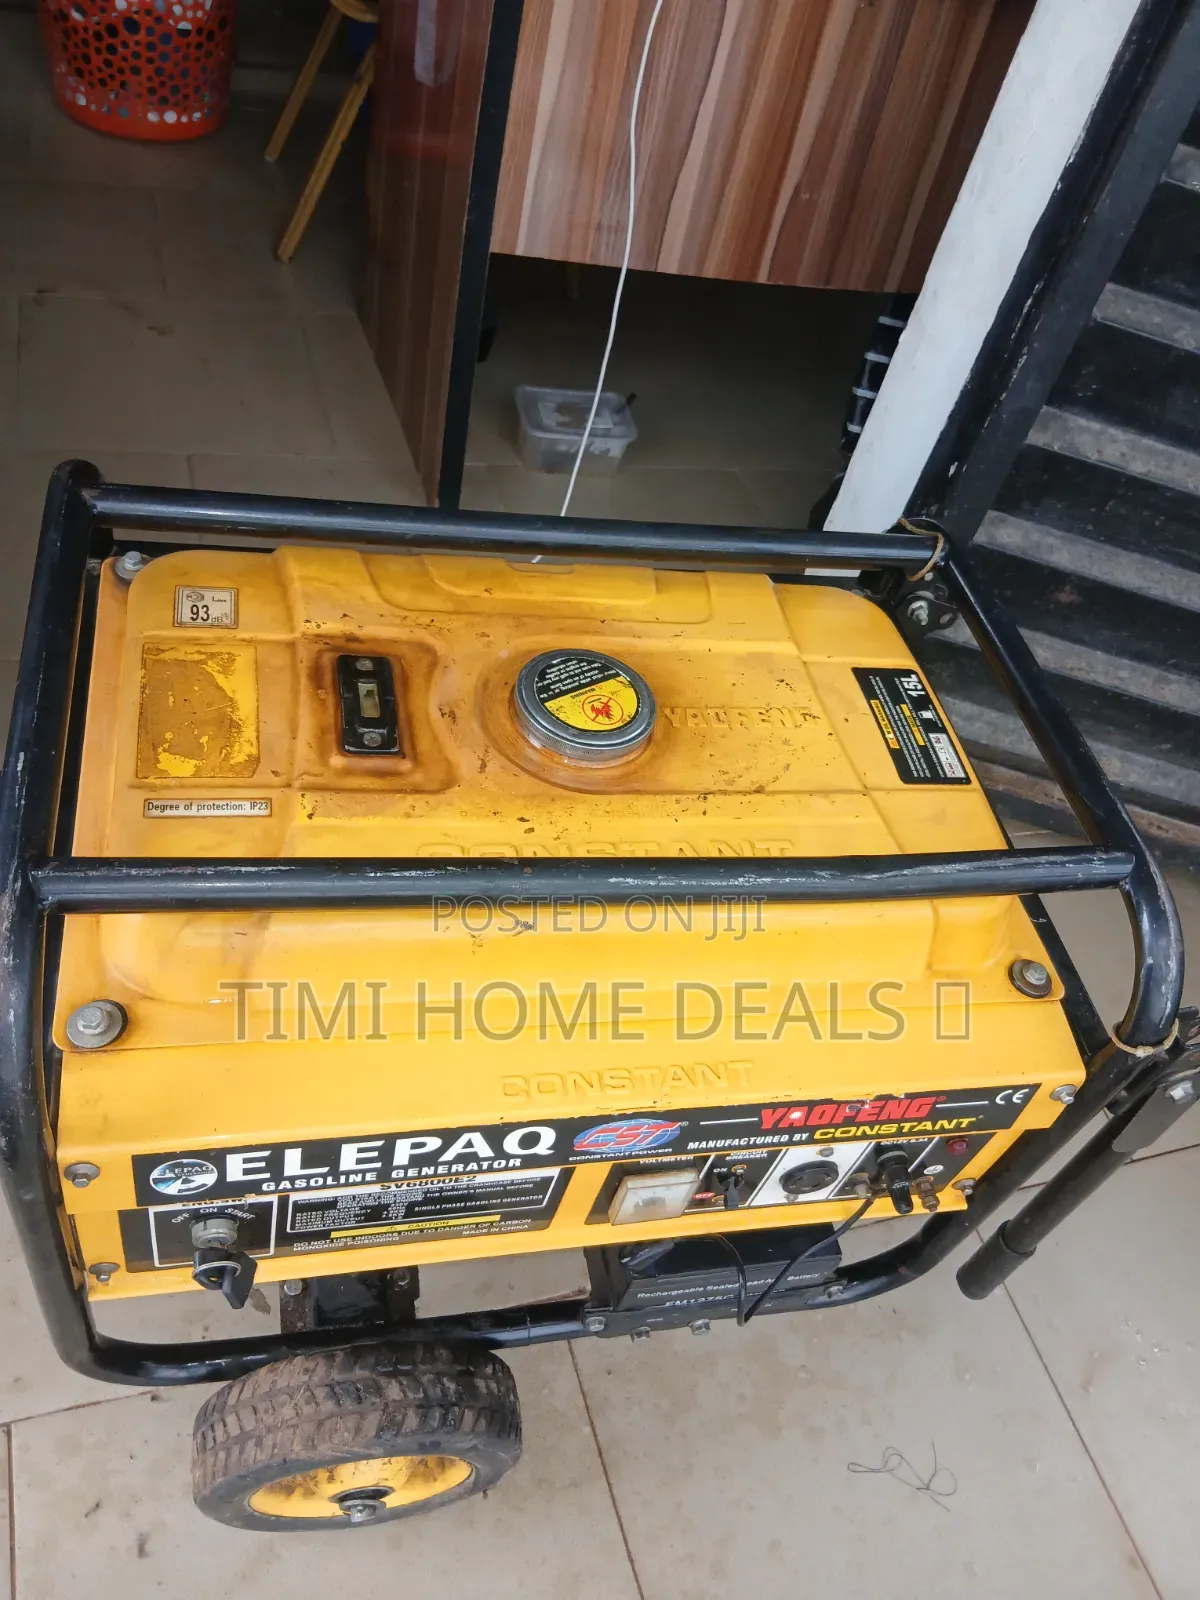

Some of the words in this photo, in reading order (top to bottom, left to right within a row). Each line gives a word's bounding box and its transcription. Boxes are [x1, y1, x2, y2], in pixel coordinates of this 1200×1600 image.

[190, 604, 210, 622] 93
[570, 688, 595, 699] WARNING
[900, 674, 926, 697] 15L
[147, 801, 180, 813] Degree
[184, 801, 193, 811] of
[197, 801, 246, 813] protection:
[250, 801, 269, 811] IP23
[500, 1060, 754, 1100] CONSTANT
[995, 1088, 1030, 1105] CE
[760, 1097, 937, 1130] YAOFENG
[687, 1134, 789, 1150] MANUFACTURED
[792, 1132, 810, 1142] BY
[813, 1117, 977, 1140] CONSTANT
[226, 1126, 557, 1182] ELEPAQ
[725, 1153, 768, 1161] BREAKER
[262, 1172, 378, 1192] GASOLINE
[391, 1157, 522, 1179] GENERATOR
[465, 1198, 501, 1206] GASOLINE
[502, 1194, 543, 1202] GENERATOR
[172, 1212, 190, 1224] OFF
[224, 1207, 256, 1220] START
[310, 1239, 331, 1247] NOT
[355, 1232, 400, 1241] INDOORS
[437, 1224, 478, 1232] DANGER
[493, 1218, 532, 1226] CARBON
[408, 1221, 449, 1229] CAUTION
[462, 1228, 489, 1236] MADE
[502, 1224, 529, 1232] CHINA
[293, 1242, 345, 1252] MONOXIDE
[347, 1236, 400, 1246] POISONING
[637, 1286, 704, 1298] Rechargeable
[706, 1282, 740, 1291] Sealed
[786, 1272, 821, 1281] Battery
